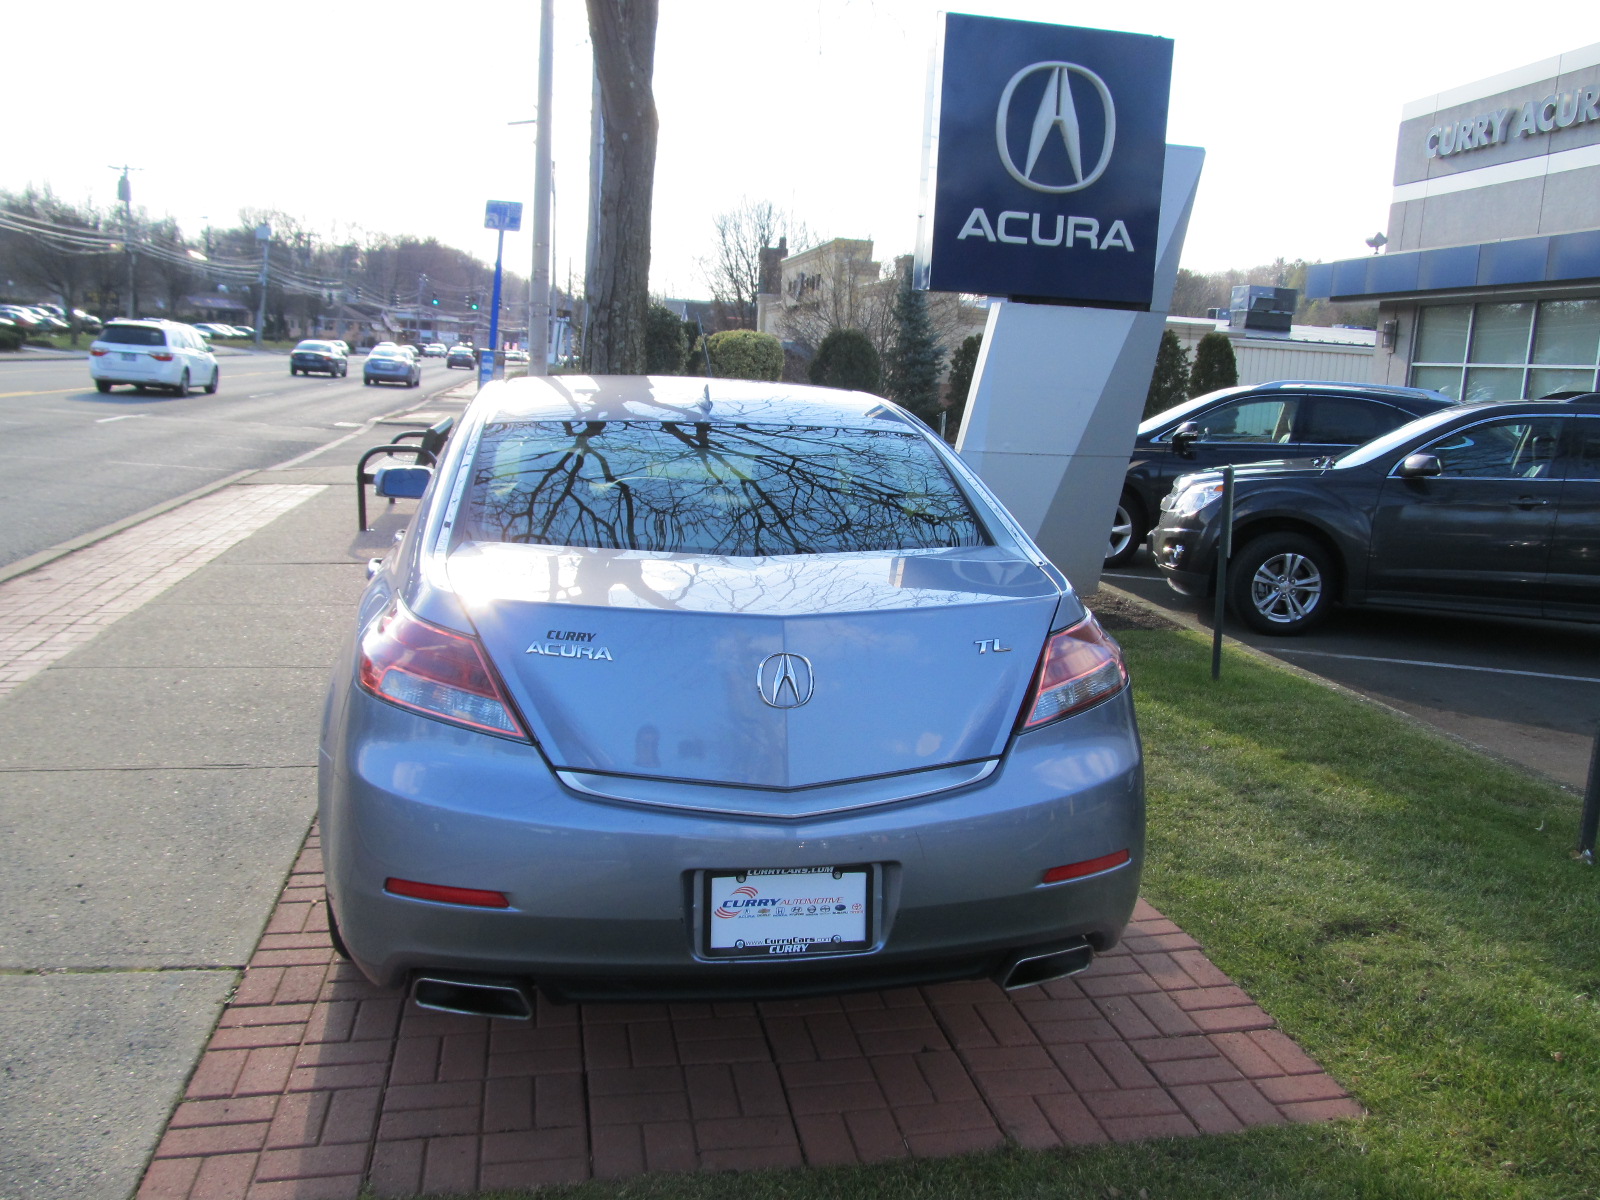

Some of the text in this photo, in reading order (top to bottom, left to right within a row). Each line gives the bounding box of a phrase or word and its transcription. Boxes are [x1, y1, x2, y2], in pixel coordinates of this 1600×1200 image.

[1425, 108, 1511, 159] CURRY
[957, 207, 1135, 252] ACURA
[546, 630, 597, 642] CURRY
[525, 640, 613, 661] ACURA
[974, 638, 1012, 654] TL
[722, 897, 845, 908] CURRY AUTOMOTIVE
[769, 943, 809, 954] CURRY
